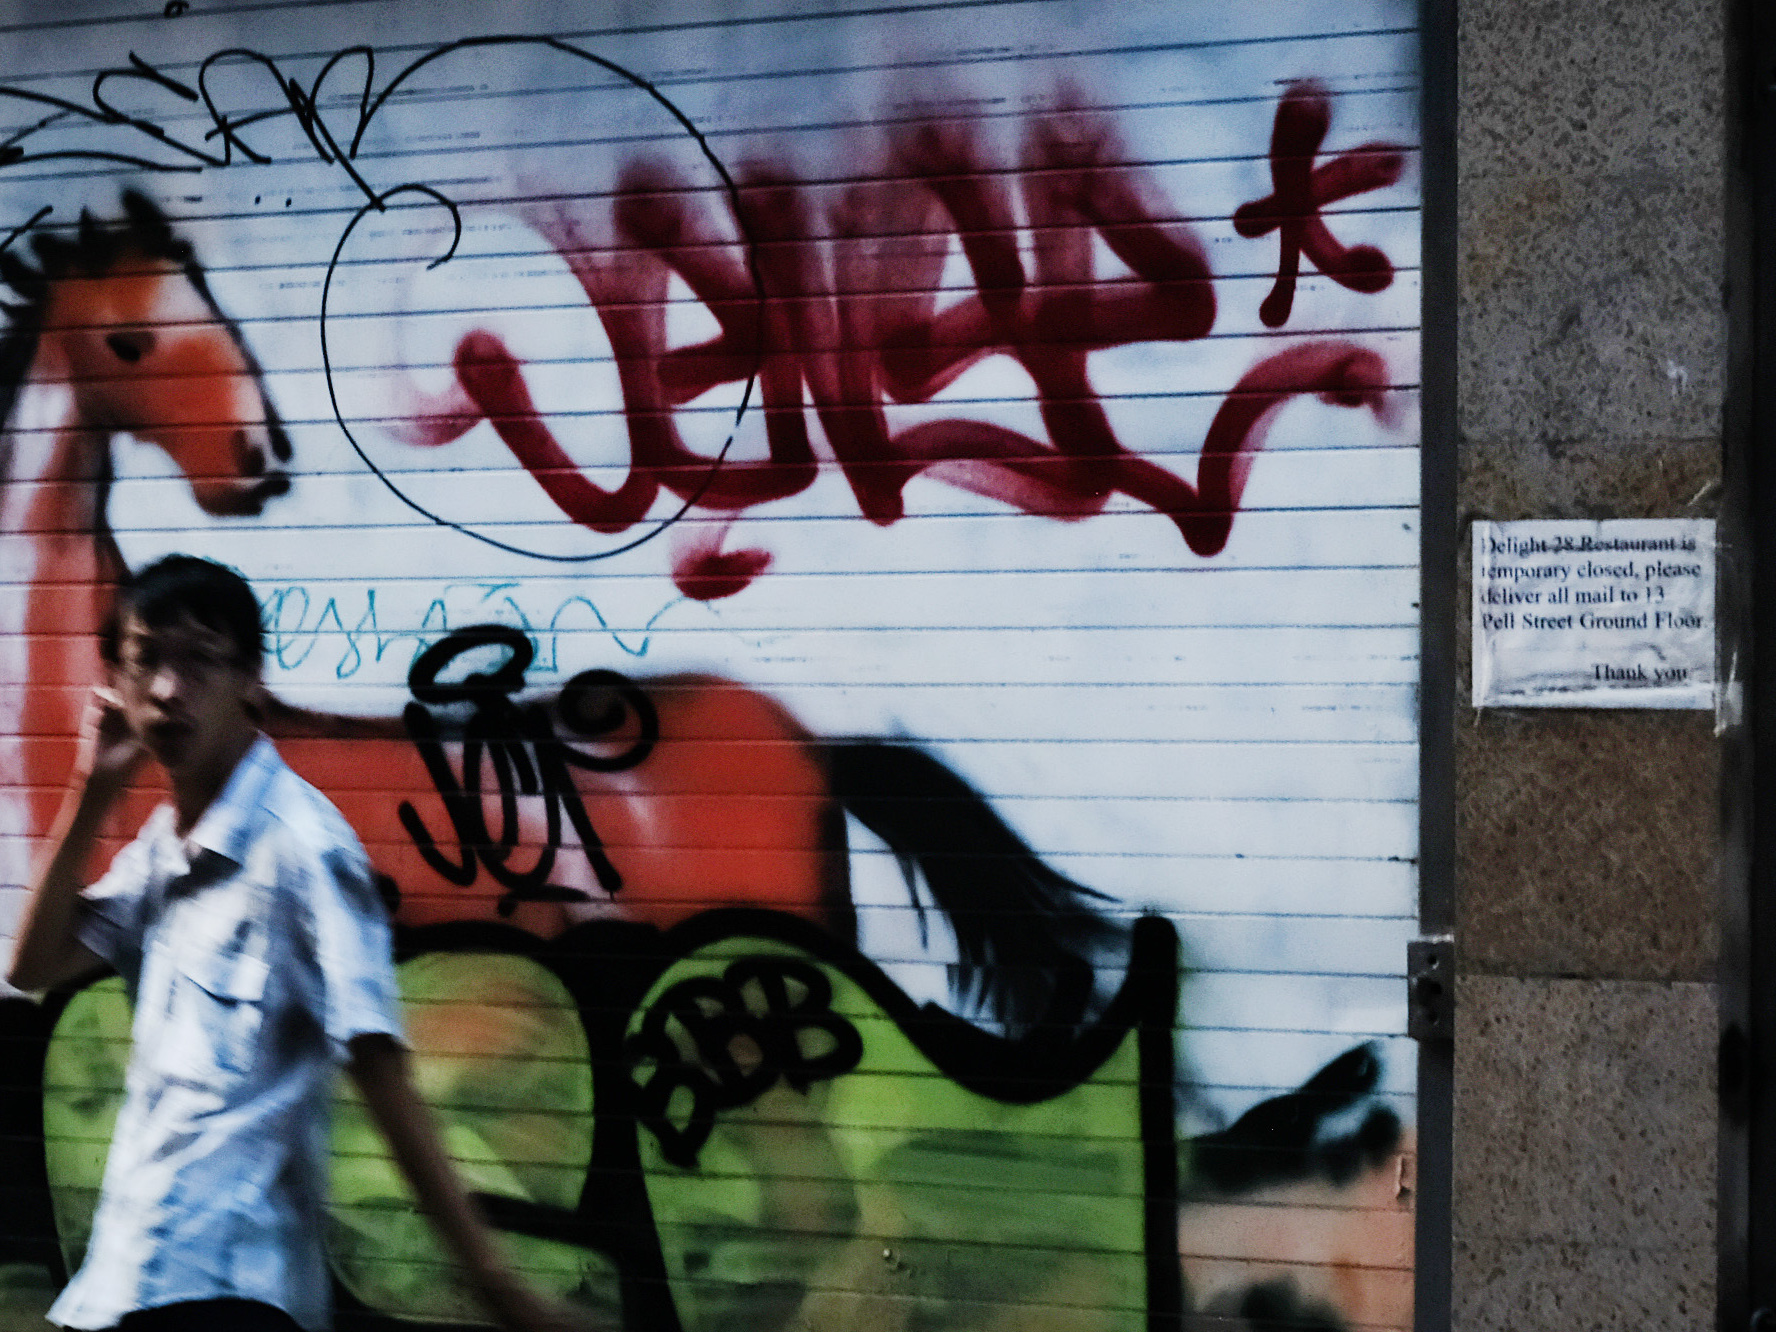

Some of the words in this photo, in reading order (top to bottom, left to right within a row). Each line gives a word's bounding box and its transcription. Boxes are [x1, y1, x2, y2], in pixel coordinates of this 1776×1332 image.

[1481, 535, 1547, 558] Delight
[1553, 535, 1574, 553] 28
[1580, 535, 1676, 553] Restaurant
[1681, 535, 1697, 552] is
[1481, 564, 1570, 582] temporary
[1577, 560, 1639, 579] closed,
[1645, 560, 1701, 581] please
[1481, 586, 1542, 604] deliver
[1547, 586, 1569, 604] all
[1575, 586, 1614, 604] mail
[1620, 588, 1638, 603] to
[1482, 613, 1515, 630] Pell
[1521, 613, 1572, 630] Street
[1579, 611, 1648, 630] Ground
[1592, 663, 1648, 682] Thank
[1653, 667, 1688, 687] you
